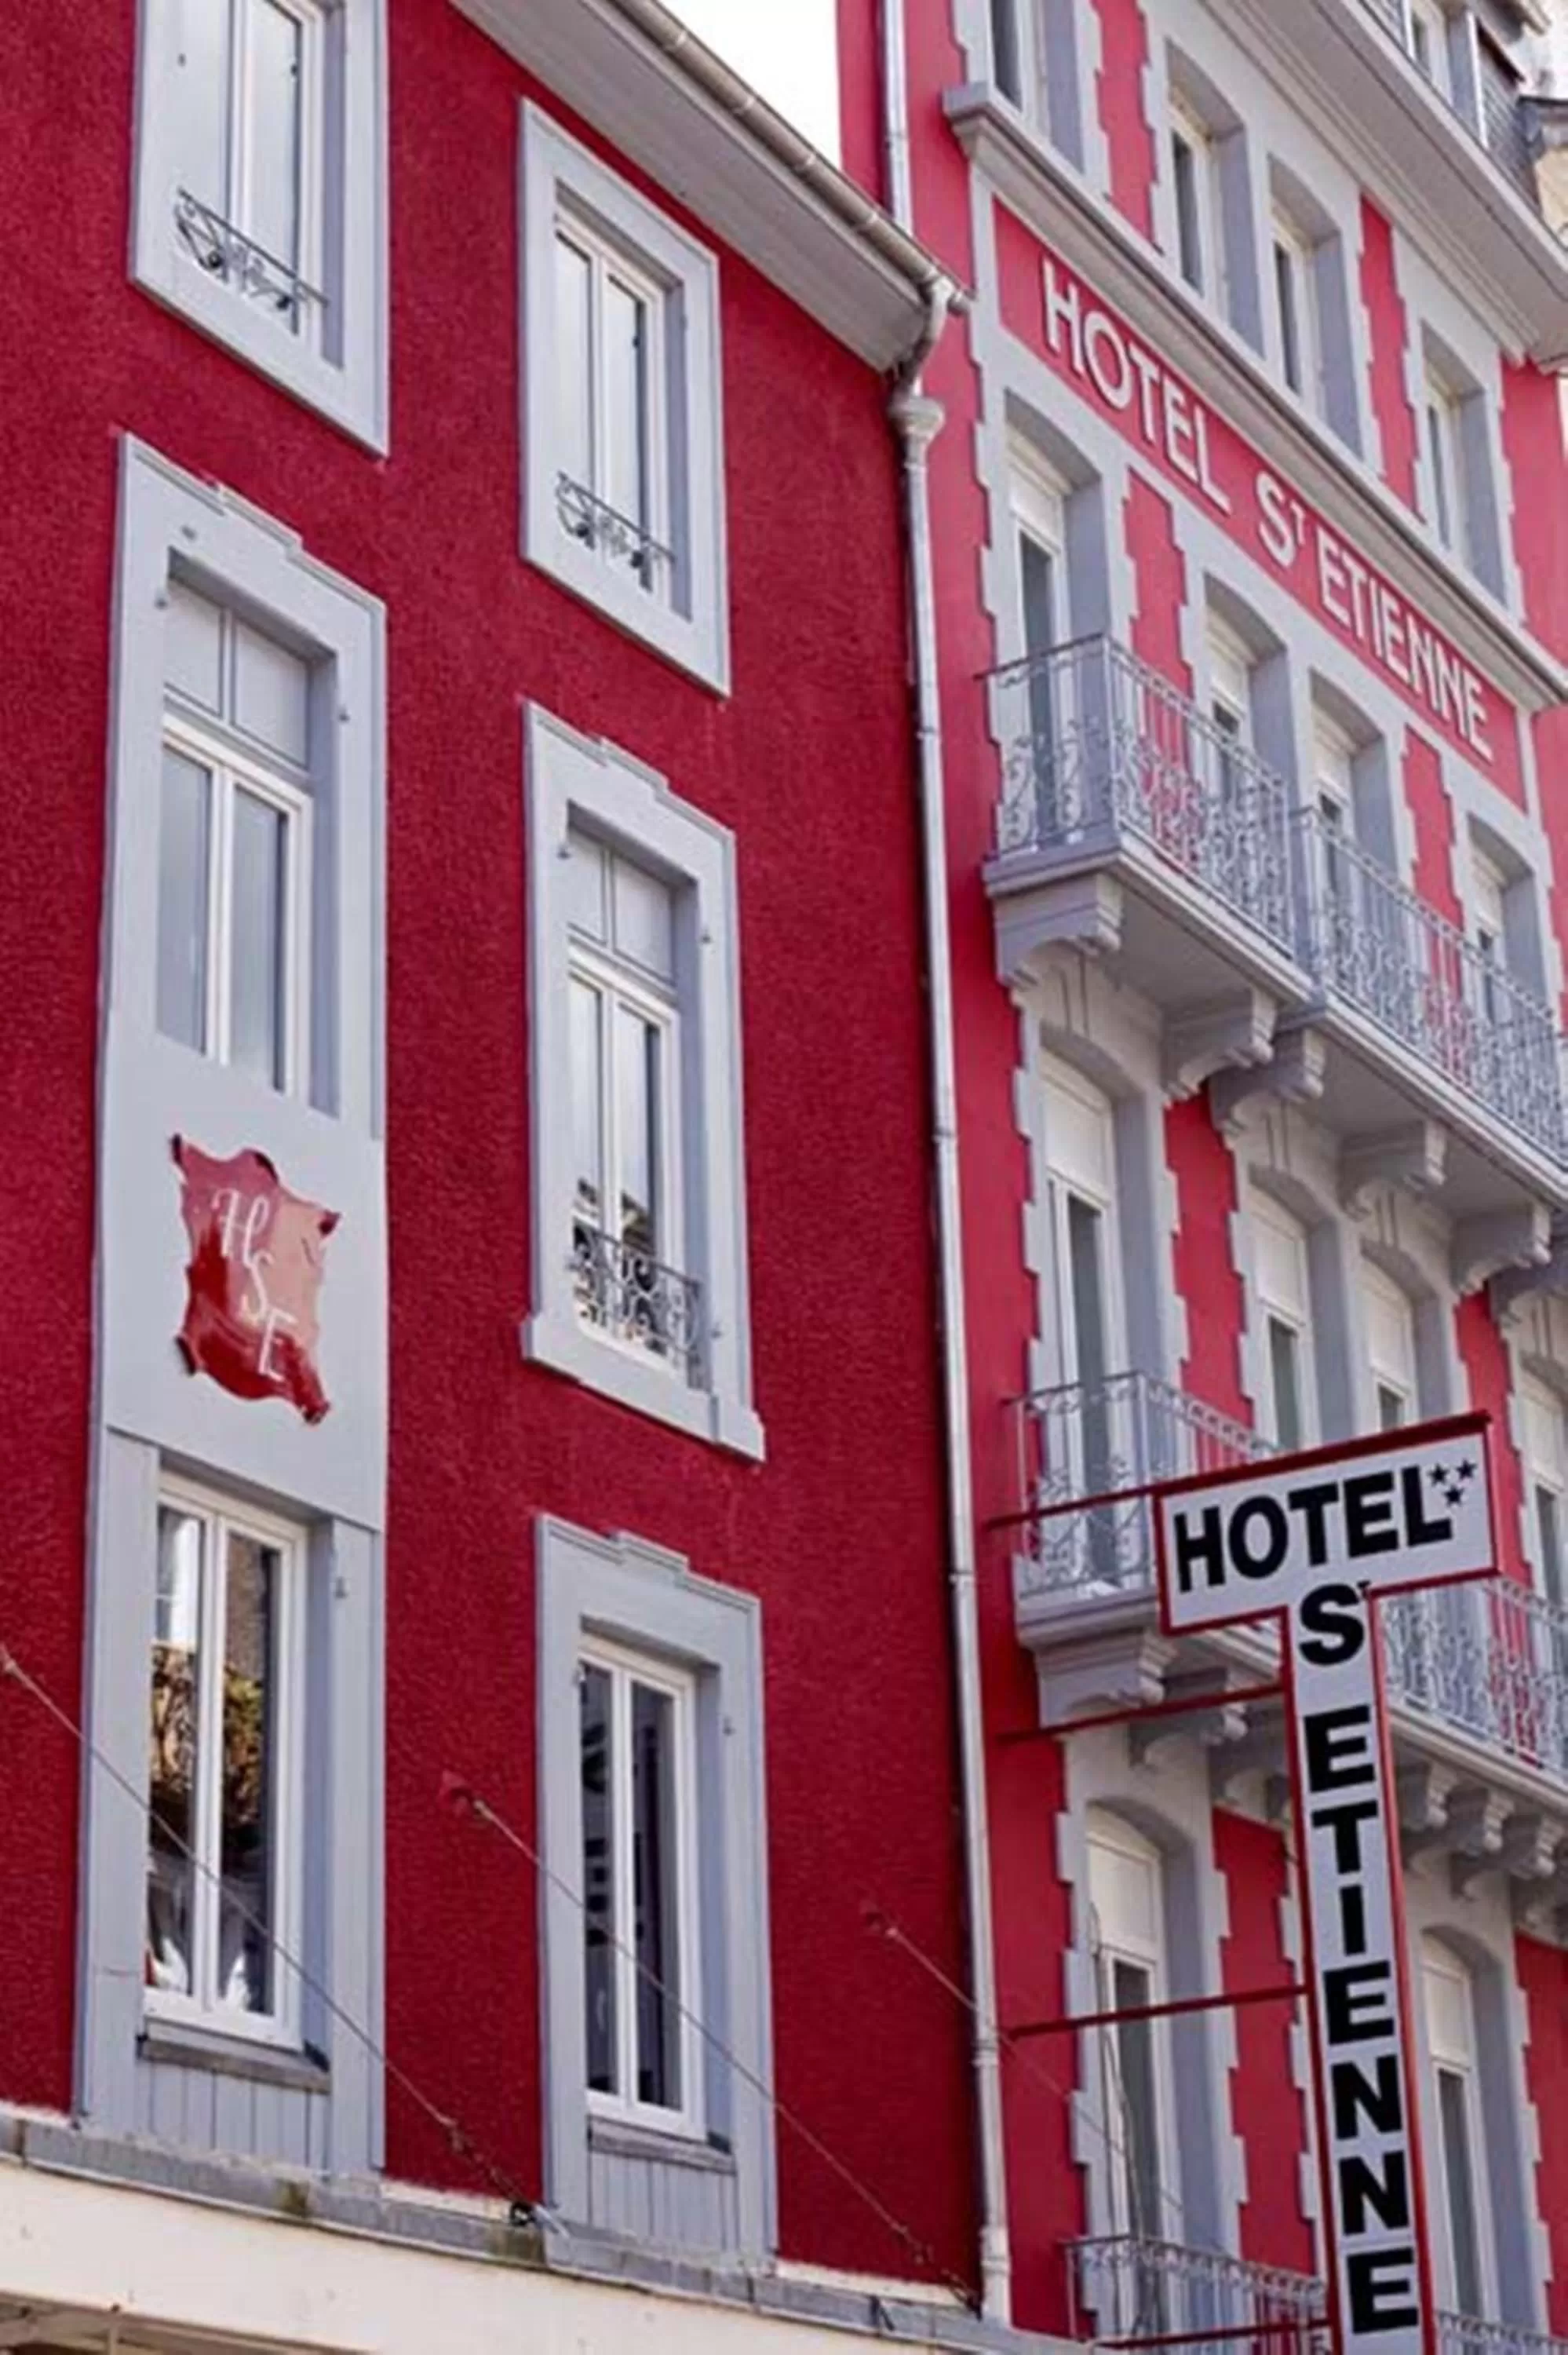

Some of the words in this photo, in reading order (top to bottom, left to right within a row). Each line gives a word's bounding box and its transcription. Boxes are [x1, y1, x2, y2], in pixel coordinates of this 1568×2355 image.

[1042, 259, 1231, 515] HOTEL
[1317, 528, 1494, 763] ETIENNE
[1174, 1466, 1453, 1593] HOTEL
[1304, 1703, 1419, 2334] ETIENNE
